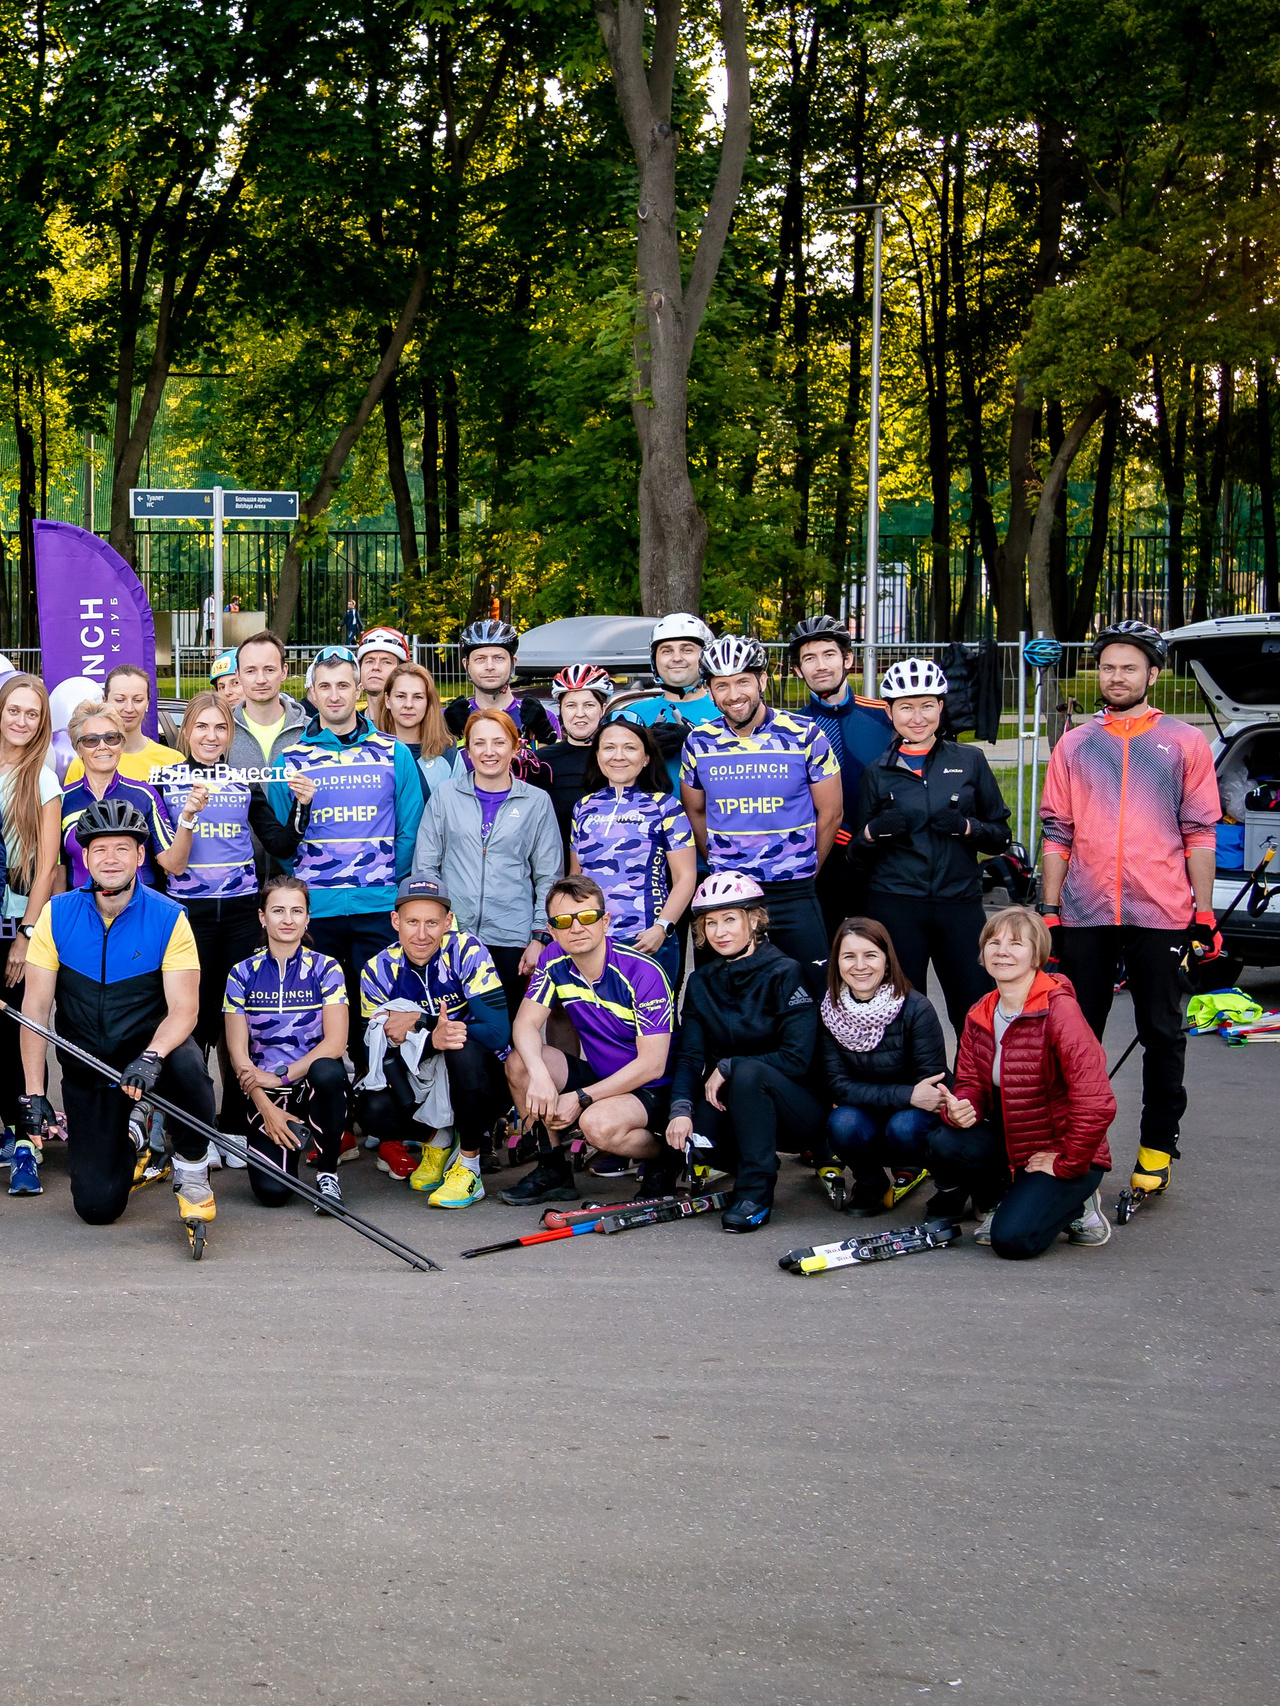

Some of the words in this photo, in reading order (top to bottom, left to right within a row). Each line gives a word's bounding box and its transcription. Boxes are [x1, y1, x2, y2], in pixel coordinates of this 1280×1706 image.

[146, 494, 164, 502] Туалет
[235, 495, 256, 503] Большая
[257, 496, 272, 504] арена
[110, 597, 120, 652] КЛУБ
[80, 598, 105, 676] NCH
[709, 763, 789, 776] GOLDFINCH
[313, 774, 381, 787] OLDFINCH
[171, 795, 246, 804] GOFINCH
[715, 796, 784, 815] ТРЕНЕР
[312, 805, 378, 824] ТРЕНЕР
[192, 822, 241, 838] РЕНЕР
[788, 996, 814, 1006] adidas
